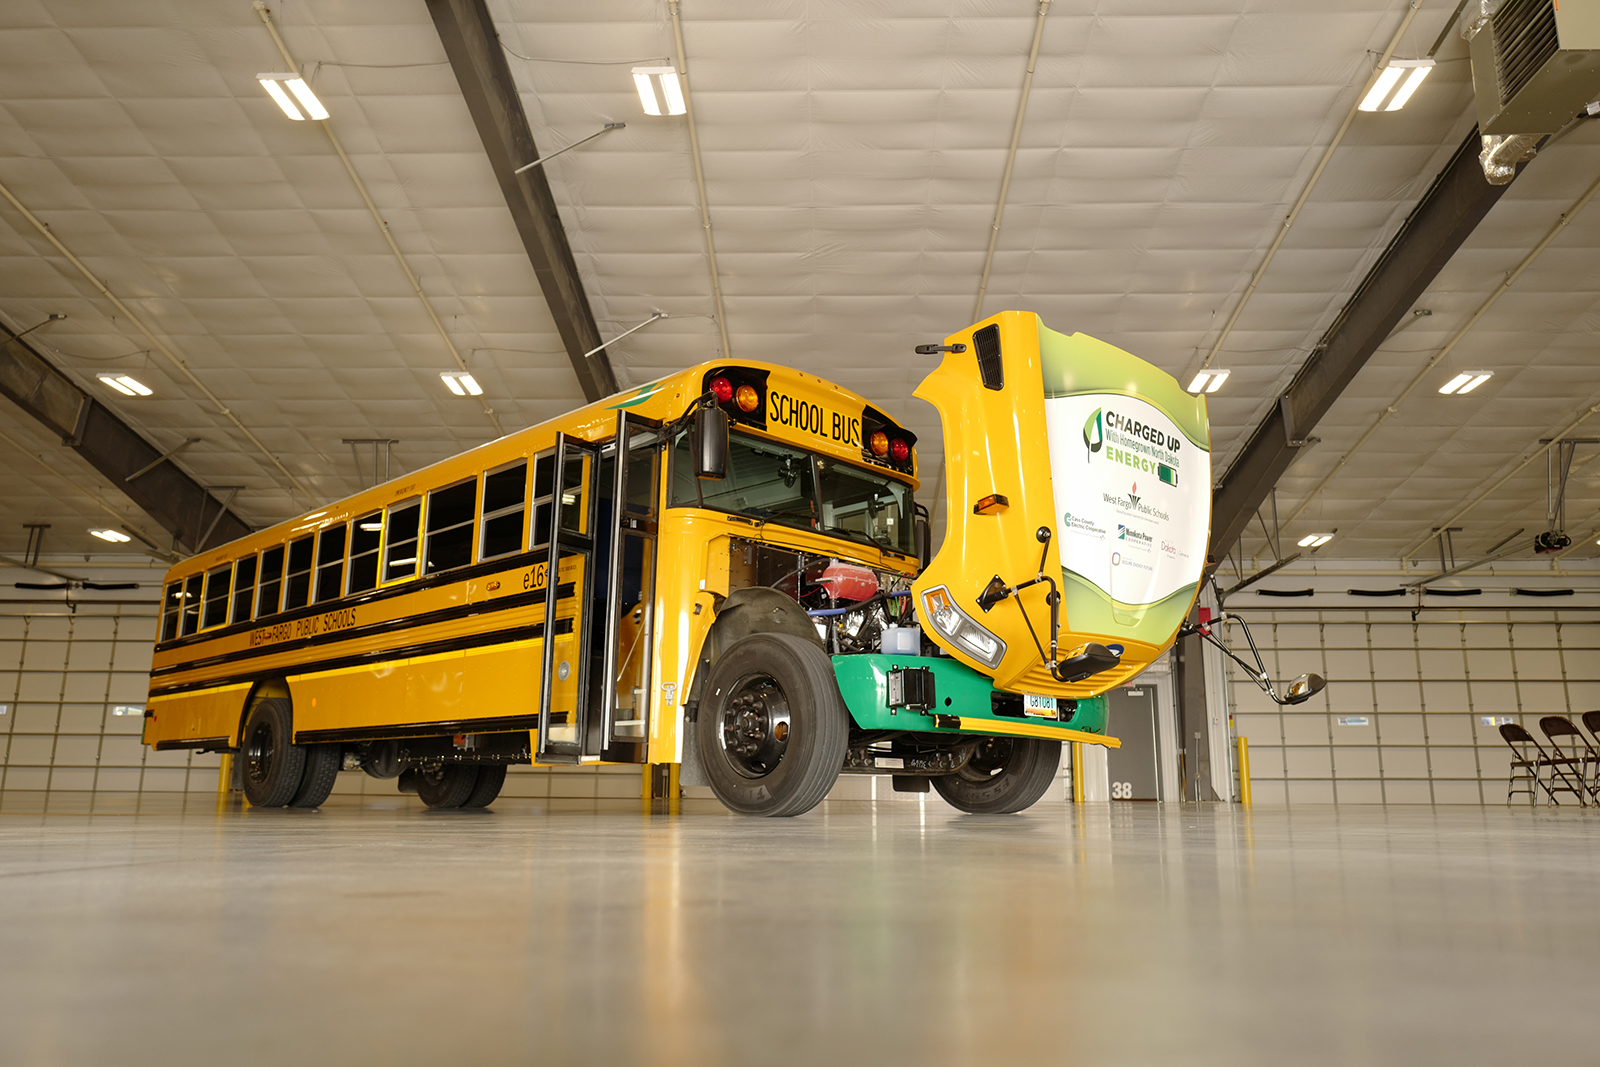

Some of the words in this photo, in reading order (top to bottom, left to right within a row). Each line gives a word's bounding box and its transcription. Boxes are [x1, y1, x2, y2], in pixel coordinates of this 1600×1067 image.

[770, 391, 828, 438] SCHOOL
[832, 411, 860, 447] BUS
[1105, 410, 1165, 447] CHARGED
[1167, 435, 1181, 453] UP
[1105, 428, 1120, 444] With
[1119, 433, 1151, 456] Homegrown
[1151, 445, 1165, 461] North
[1165, 451, 1180, 468] Dakota
[1106, 445, 1156, 475] ENERGY
[1103, 492, 1117, 505] West
[1117, 496, 1132, 510] Fargo
[1138, 502, 1153, 516] Public
[1153, 507, 1170, 521] Schools
[1161, 540, 1177, 555] Dakota
[522, 564, 544, 590] e16
[249, 628, 266, 647] WEST
[271, 623, 292, 642] FARGO
[296, 616, 320, 637] PUBLIC
[322, 608, 356, 632] SCHOOLS
[1112, 781, 1132, 799] 38
